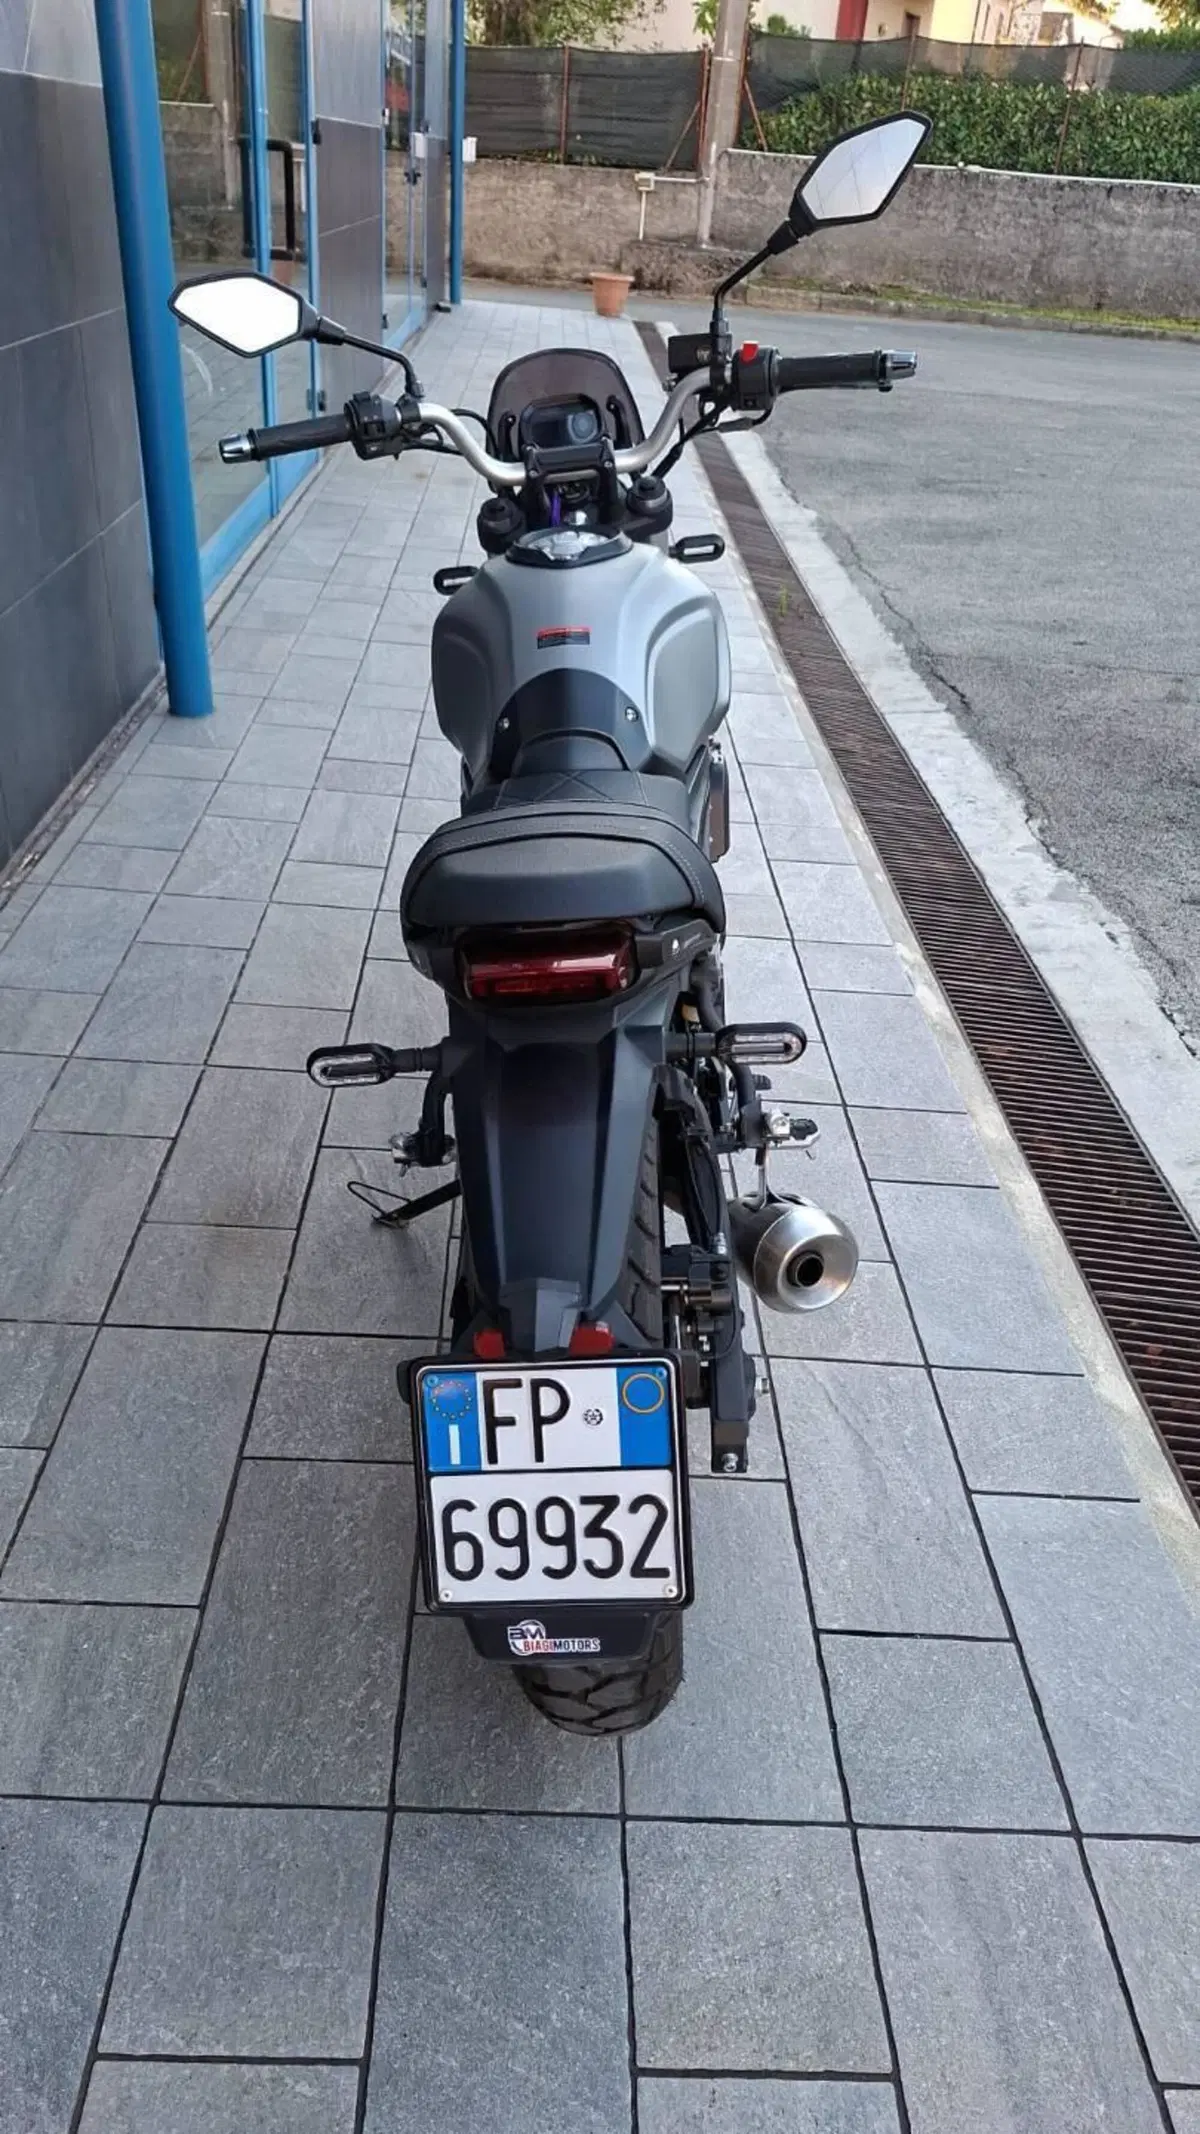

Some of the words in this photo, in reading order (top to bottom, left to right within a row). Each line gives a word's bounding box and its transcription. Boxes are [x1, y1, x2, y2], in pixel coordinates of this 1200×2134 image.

[449, 1424, 461, 1465] I
[482, 1377, 571, 1465] FP
[441, 1494, 670, 1581] 69932
